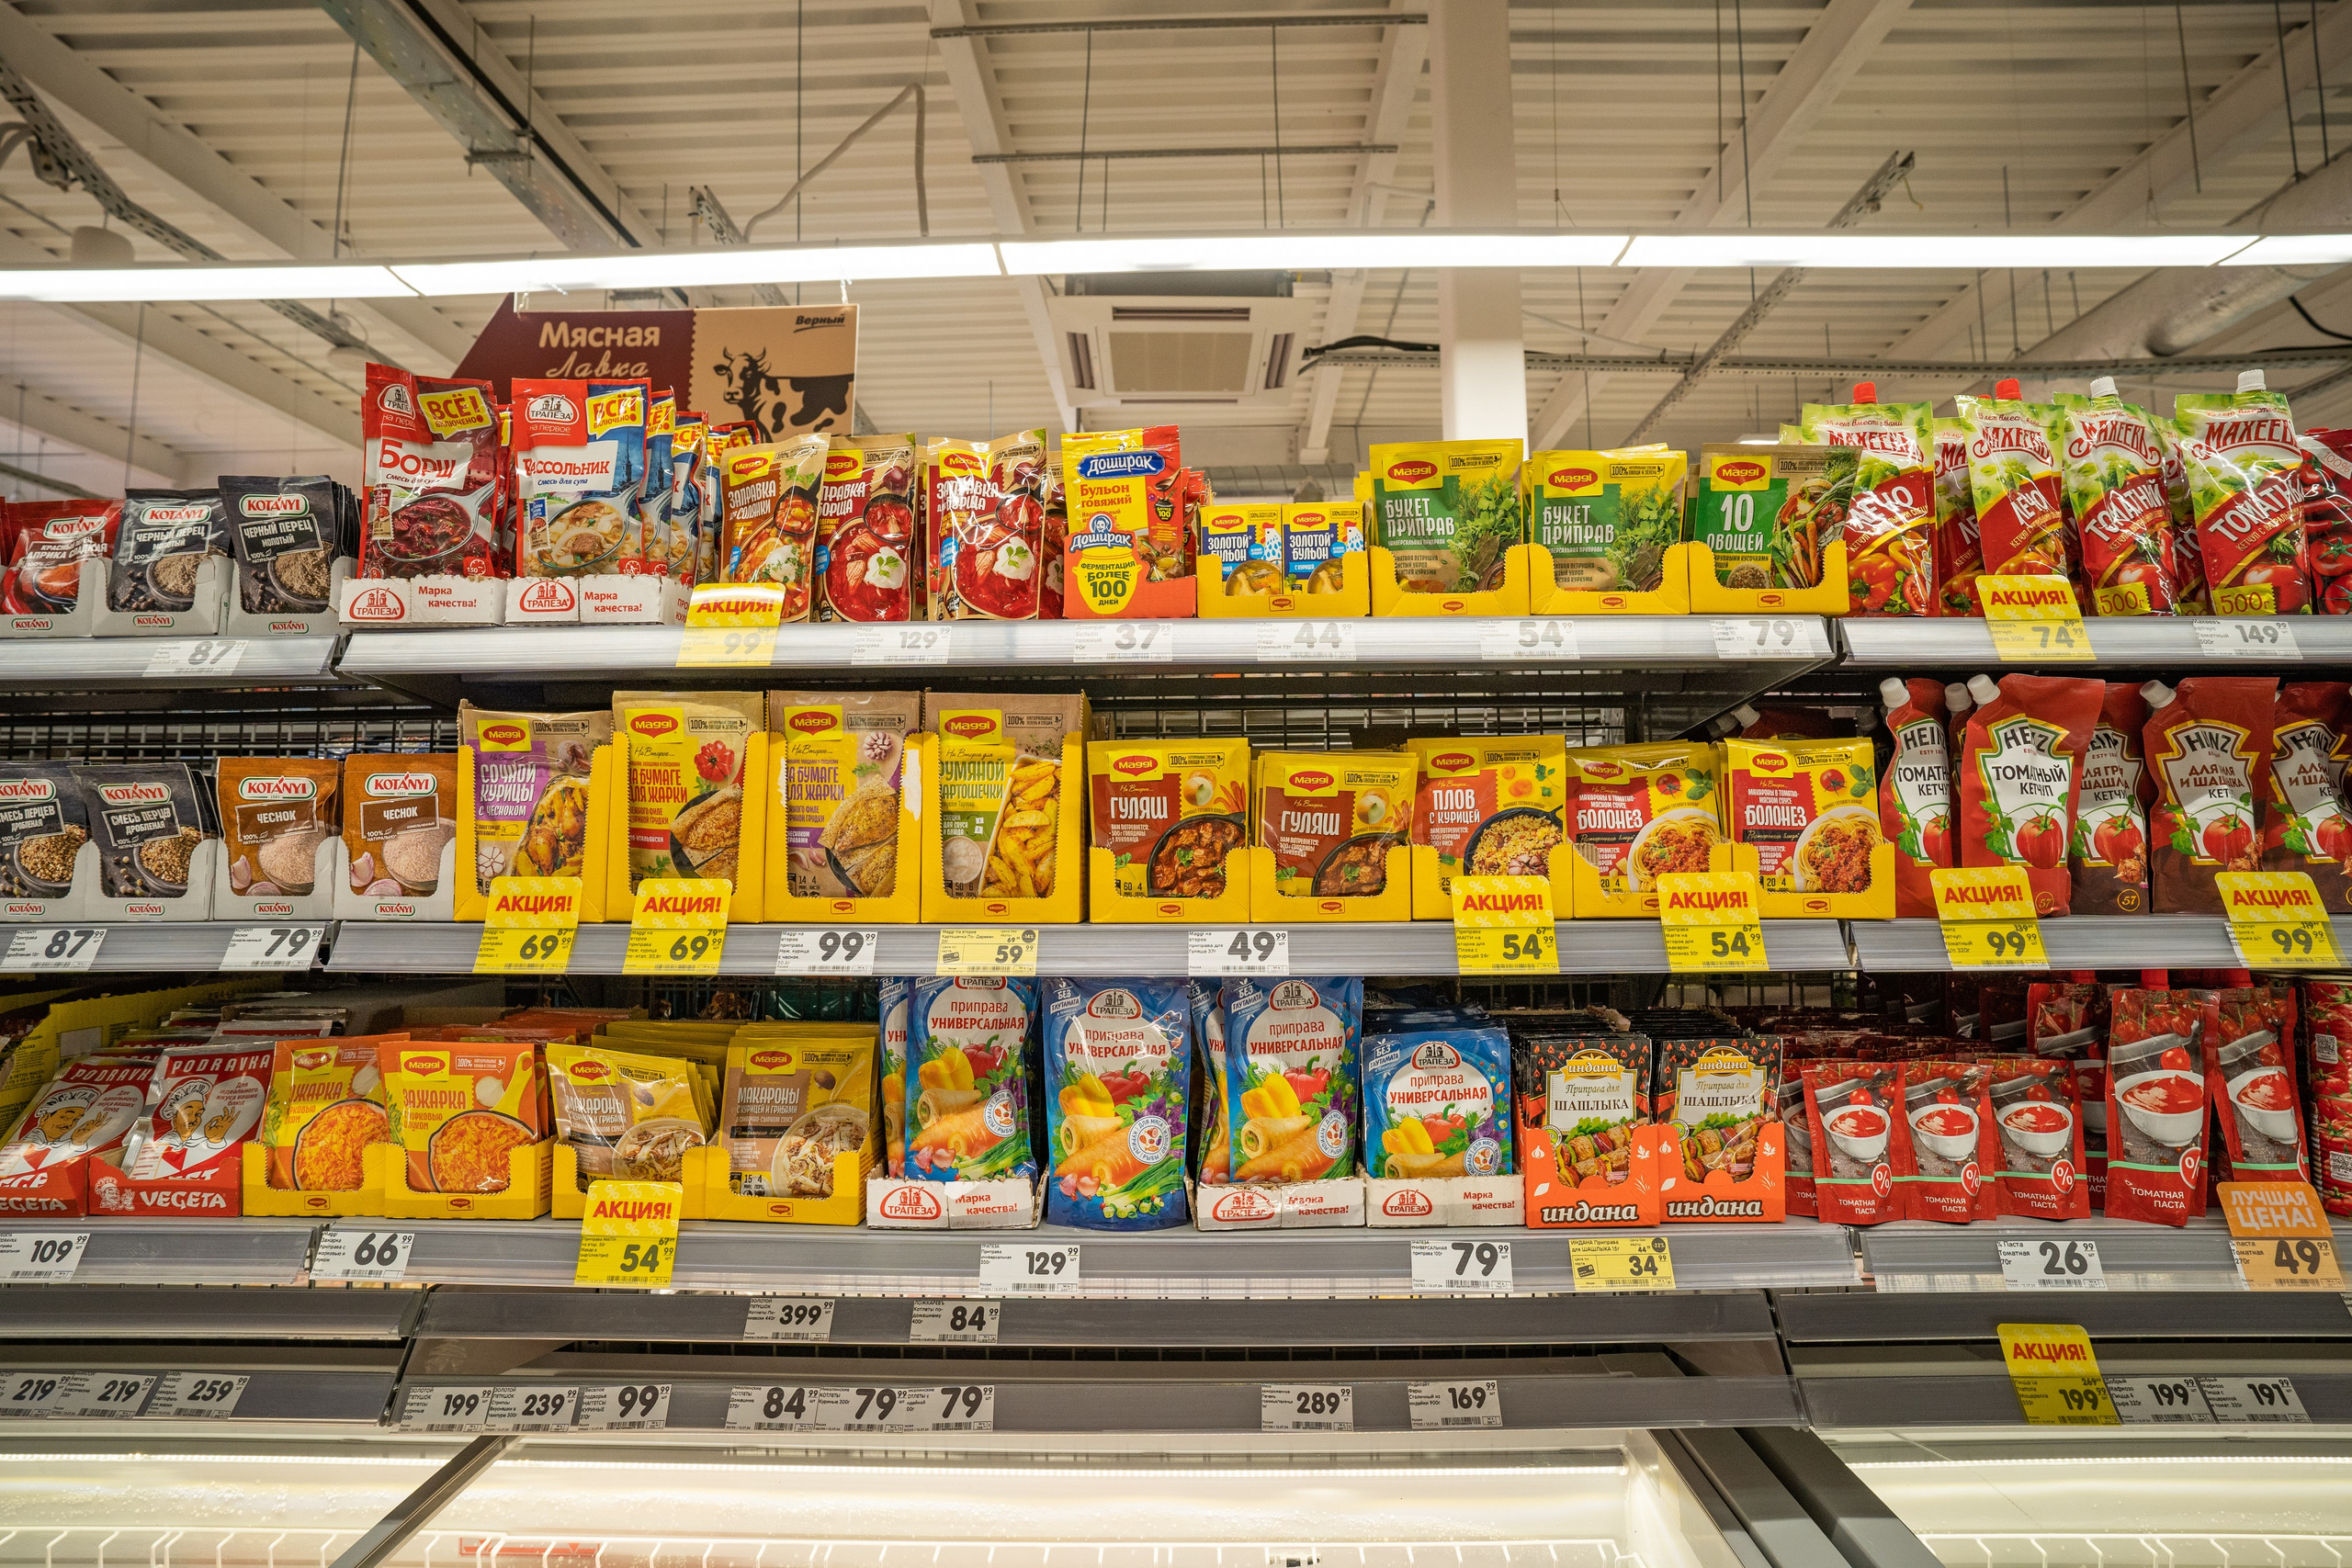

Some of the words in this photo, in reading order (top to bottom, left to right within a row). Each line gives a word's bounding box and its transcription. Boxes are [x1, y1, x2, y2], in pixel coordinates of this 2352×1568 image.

[795, 314, 844, 326] Верный
[538, 321, 660, 348] Мясная
[546, 351, 649, 378] Лавка
[428, 390, 484, 423] ВСЁ!
[531, 410, 573, 420] ТРАПЕЗА
[435, 416, 477, 428] ВКЛЮЧЕНО
[735, 459, 763, 472] Maggi
[1088, 454, 1154, 475] Доширак
[1394, 466, 1431, 477] Maggi
[1722, 468, 1759, 478] Maggi
[729, 481, 776, 508] ЗАПРАВКА
[1080, 484, 1130, 497] Бульон
[247, 494, 300, 512] KOTÁNYI
[737, 502, 771, 521] СОЛЯНКИ
[1081, 495, 1132, 509] говяжий
[1385, 498, 1430, 518] БУКЕТ
[1846, 485, 1914, 532] ЛЕЧО
[1297, 515, 1321, 524] Maggi
[1721, 494, 1754, 531] 10
[244, 523, 277, 539] ЧЕРНЫЙ
[279, 518, 312, 533] ПЕРЕЦ
[1386, 517, 1454, 538] ПРИПРАВ
[262, 535, 294, 547] МОЛОТЫЙ
[1071, 532, 1133, 549] Доширак
[1290, 534, 1330, 547] ЗОЛОТОЙ
[1707, 532, 1763, 552] ОВОЩЕЙ
[1292, 547, 1329, 560] БУЛЬОН
[1081, 561, 1136, 571] ФЕРМЕНТАЦИЯ
[1090, 571, 1128, 581] БОЛЕЕ
[418, 587, 452, 595] Марка
[1091, 580, 1126, 597] 100
[1990, 589, 2067, 608] АКЦИЯ!
[357, 607, 399, 615] ТРАПЕЗА
[428, 599, 476, 608] качества!
[696, 596, 773, 614] АКЦИЯ!
[1099, 597, 1119, 605] ДНЕЙ
[2100, 592, 2144, 615] 500г
[723, 633, 762, 654] 99
[899, 632, 937, 649] 129
[1114, 624, 1159, 649] 37
[1294, 623, 1341, 649] 44
[1519, 622, 1563, 647] 54
[1748, 621, 1794, 646] 79
[2031, 626, 2072, 648] 74
[2235, 625, 2278, 645] 149
[188, 641, 236, 664] 87
[489, 730, 521, 740] Maggi
[951, 720, 989, 731] Maggi
[1118, 761, 1153, 770] Maggi
[1436, 757, 1470, 766] Maggi
[374, 773, 429, 791] KOTÁNYI
[481, 763, 537, 784] СОЧНОЙ
[640, 768, 681, 785] БУМАГЕ
[248, 776, 307, 795] KOTÁNYI
[480, 784, 534, 803] КУРИЦЫ
[647, 786, 687, 804] ЖАРКИ
[2020, 783, 2052, 797] КЕТЧУП
[1110, 796, 1168, 818] ГУЛЯШ
[1433, 789, 1476, 810] ПЛОВ
[111, 811, 142, 825] СМЕСЬ
[144, 808, 171, 823] ПЕРЦЕВ
[256, 810, 296, 824] ЧЕСНОК
[487, 806, 526, 816] ЧЕСНОКОМ
[1438, 809, 1480, 825] КУРИЦЕЙ
[1745, 805, 1807, 827] БОЛОНЕЗ
[126, 821, 165, 834] ДРОБЛЕНАЯ
[1281, 811, 1340, 836] ГУЛЯШ
[1463, 894, 1543, 913] АКЦИЯ!
[1668, 892, 1748, 910] АКЦИЯ!
[1945, 885, 2022, 904] АКЦИЯ!
[2233, 890, 2313, 906] АКЦИЯ!
[496, 896, 571, 914] АКЦИЯ!
[44, 930, 95, 958] 87
[265, 929, 310, 957] 79
[520, 935, 559, 960] 69
[671, 935, 709, 960] 69
[820, 932, 863, 962] 99
[1227, 932, 1275, 962] 49
[1503, 934, 1542, 959] 54
[1712, 931, 1750, 956] 54
[1987, 931, 2025, 957] 99
[2271, 929, 2312, 955] 99
[995, 946, 1023, 964] 59
[950, 1000, 1008, 1015] приправа
[932, 1017, 1024, 1032] УНИВЕРСАЛЬНАЯ
[172, 1054, 268, 1075] PODRAVKA
[409, 1061, 440, 1070] Maggi
[754, 1055, 787, 1064] Maggi
[1418, 1057, 1454, 1066] ТРАПЕЗА
[1567, 1062, 1617, 1074] индана
[1410, 1073, 1464, 1087] приправа
[403, 1089, 465, 1110] ЗАЖАРКА
[737, 1086, 799, 1105] МАКАРОНЫ
[1390, 1087, 1487, 1103] УНИВЕРСАЛЬНАЯ
[1566, 1084, 1604, 1097] Приправа
[1606, 1085, 1620, 1094] для
[1555, 1099, 1629, 1111] ШАШЛЫКА
[140, 1190, 226, 1213] VEGETA
[2132, 1188, 2184, 1199] ТОМАТНАЯ
[2232, 1190, 2305, 1206] ЛУЧШАЯ
[594, 1201, 672, 1220] АКЦИЯ!
[888, 1205, 935, 1215] ТРАПЕЗА
[1542, 1200, 1638, 1223] индана
[2154, 1200, 2185, 1209] ПАСТА
[2238, 1209, 2316, 1230] ЦЕНА!
[30, 1240, 73, 1263] 109
[354, 1233, 398, 1266] 66
[620, 1245, 659, 1272] 54
[1452, 1243, 1498, 1276] 79
[2039, 1241, 2087, 1275] 26
[2275, 1240, 2320, 1275] 49
[1026, 1252, 1066, 1275] 129
[1630, 1256, 1658, 1276] 34
[779, 1305, 821, 1325] 399
[950, 1306, 986, 1331] 84
[2013, 1343, 2086, 1362] АКЦИЯ!
[13, 1380, 56, 1401] 219
[97, 1380, 140, 1402] 219
[187, 1379, 233, 1402] 259
[1448, 1387, 1487, 1408] 169
[2058, 1389, 2099, 1410] 199
[2148, 1384, 2189, 1404] 199
[2247, 1384, 2288, 1404] 191
[443, 1394, 479, 1416] 199
[521, 1394, 565, 1416] 239
[618, 1386, 659, 1417] 99
[763, 1388, 806, 1418] 84
[854, 1388, 896, 1420] 79
[941, 1386, 981, 1418] 79
[1297, 1393, 1340, 1414] 289
